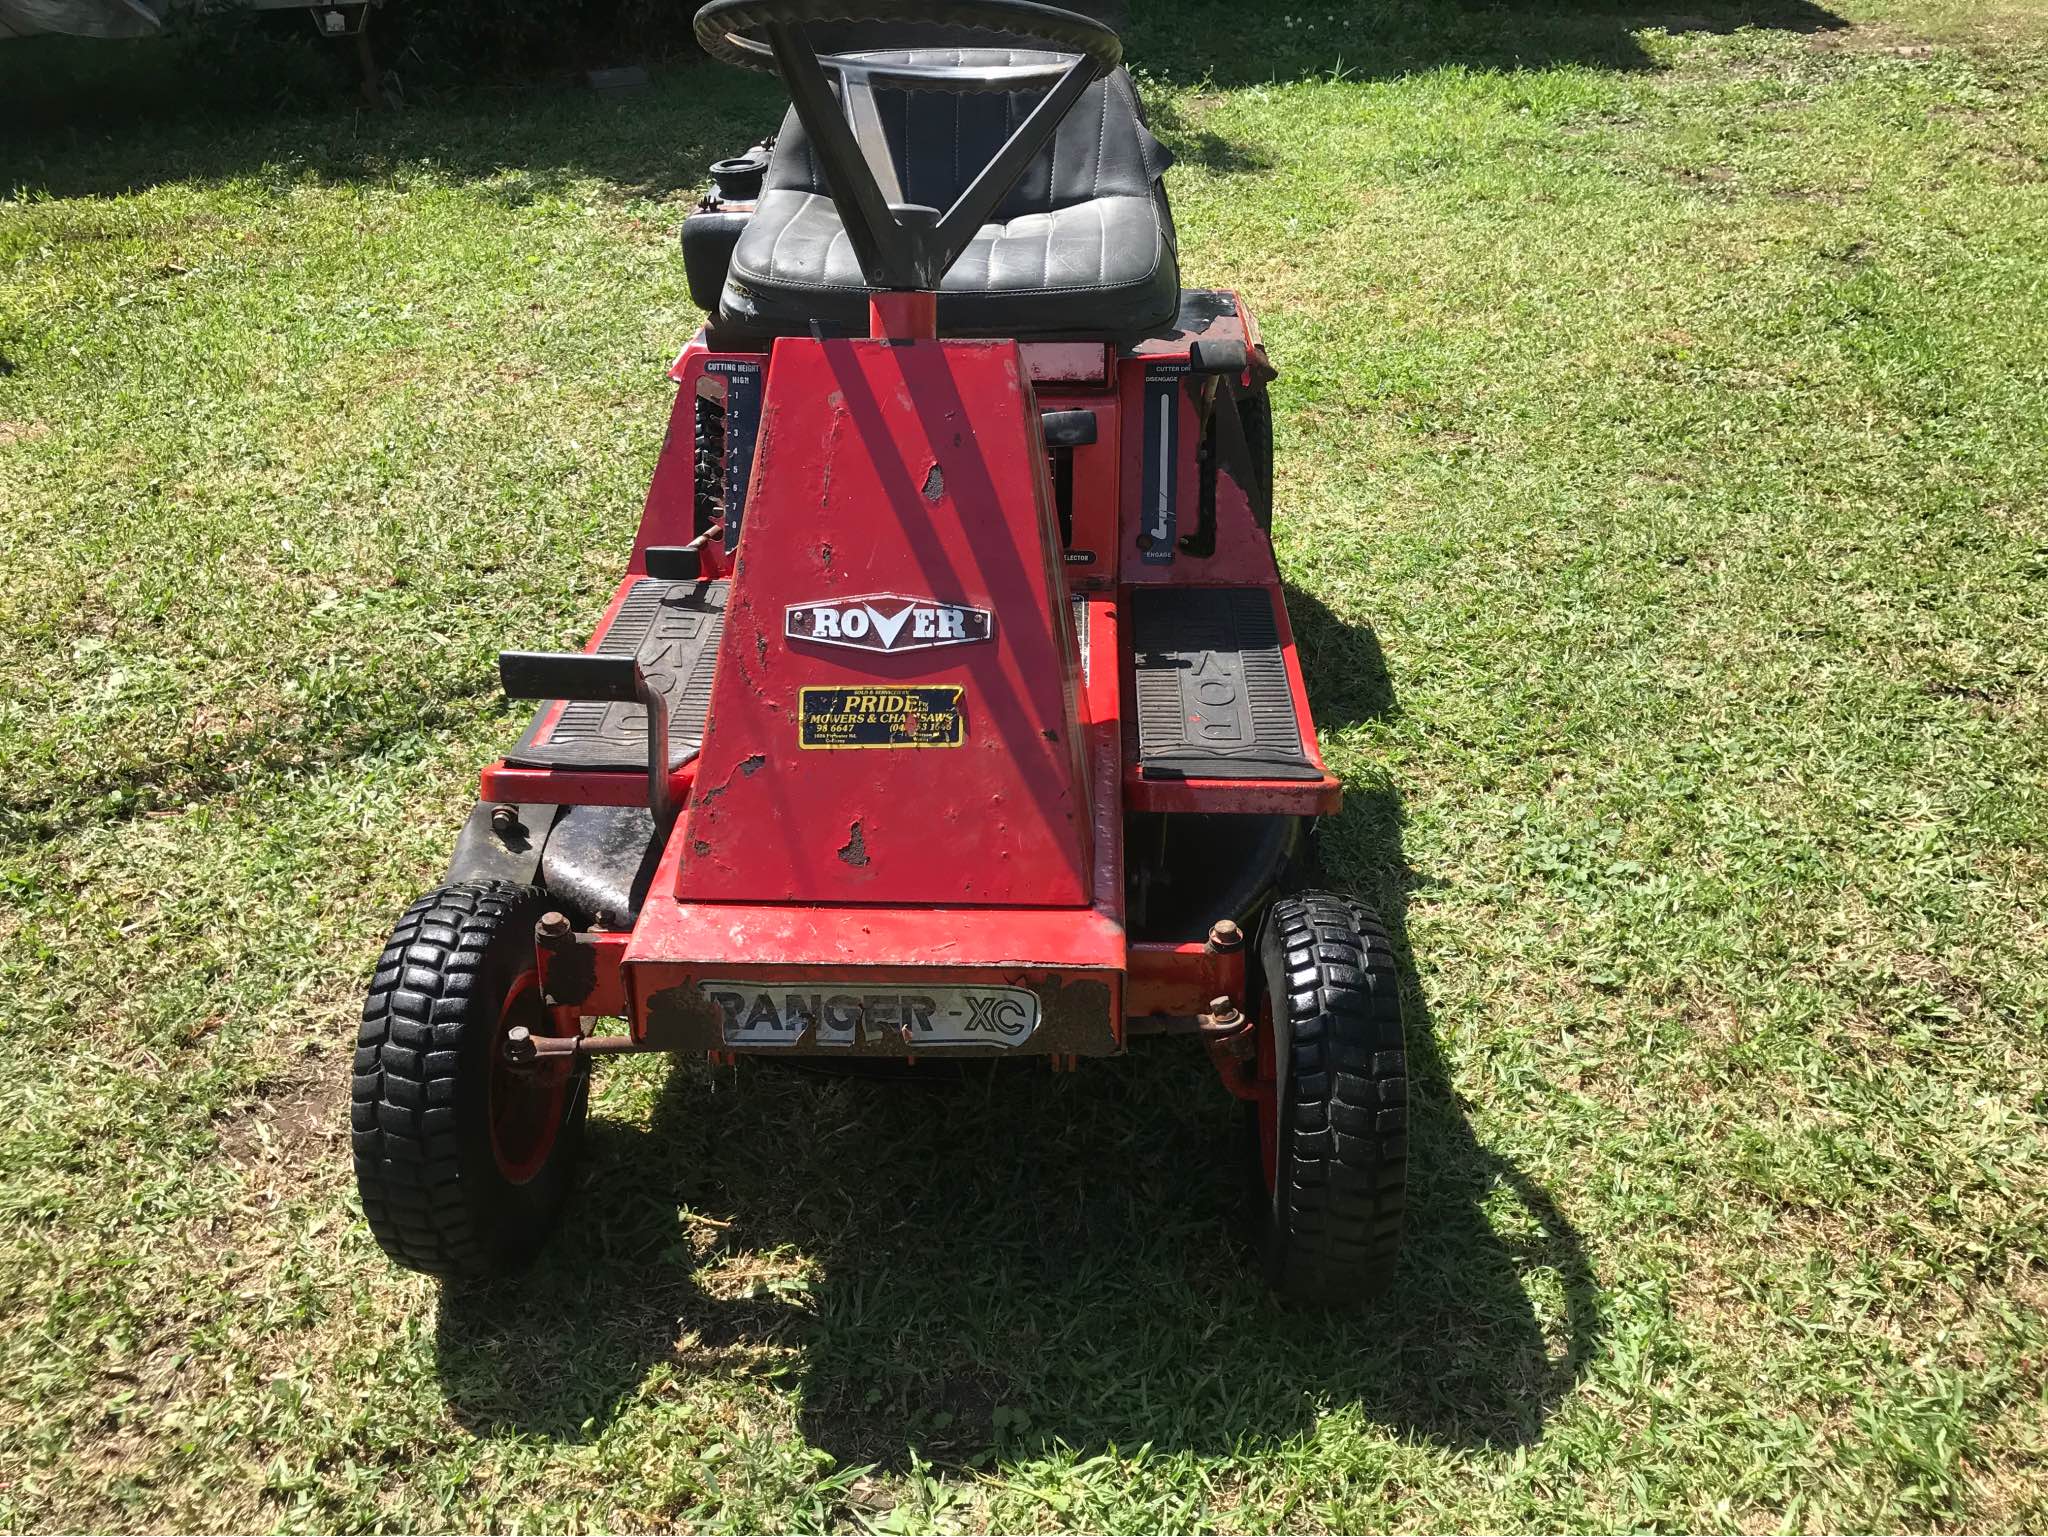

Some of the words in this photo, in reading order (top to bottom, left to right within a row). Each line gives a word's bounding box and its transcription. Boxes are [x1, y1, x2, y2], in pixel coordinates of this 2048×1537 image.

[708, 363, 736, 371] CUTTING
[737, 364, 759, 372] HEIGHT
[732, 376, 749, 384] HIGH
[812, 602, 966, 649] ROVER
[843, 695, 919, 713] PRIDE
[810, 714, 864, 724] MOWERS
[867, 714, 876, 724] &
[880, 713, 953, 723] CHASAWS
[816, 724, 828, 732] 98
[830, 724, 854, 732] 6647
[709, 992, 937, 1032] RANGER
